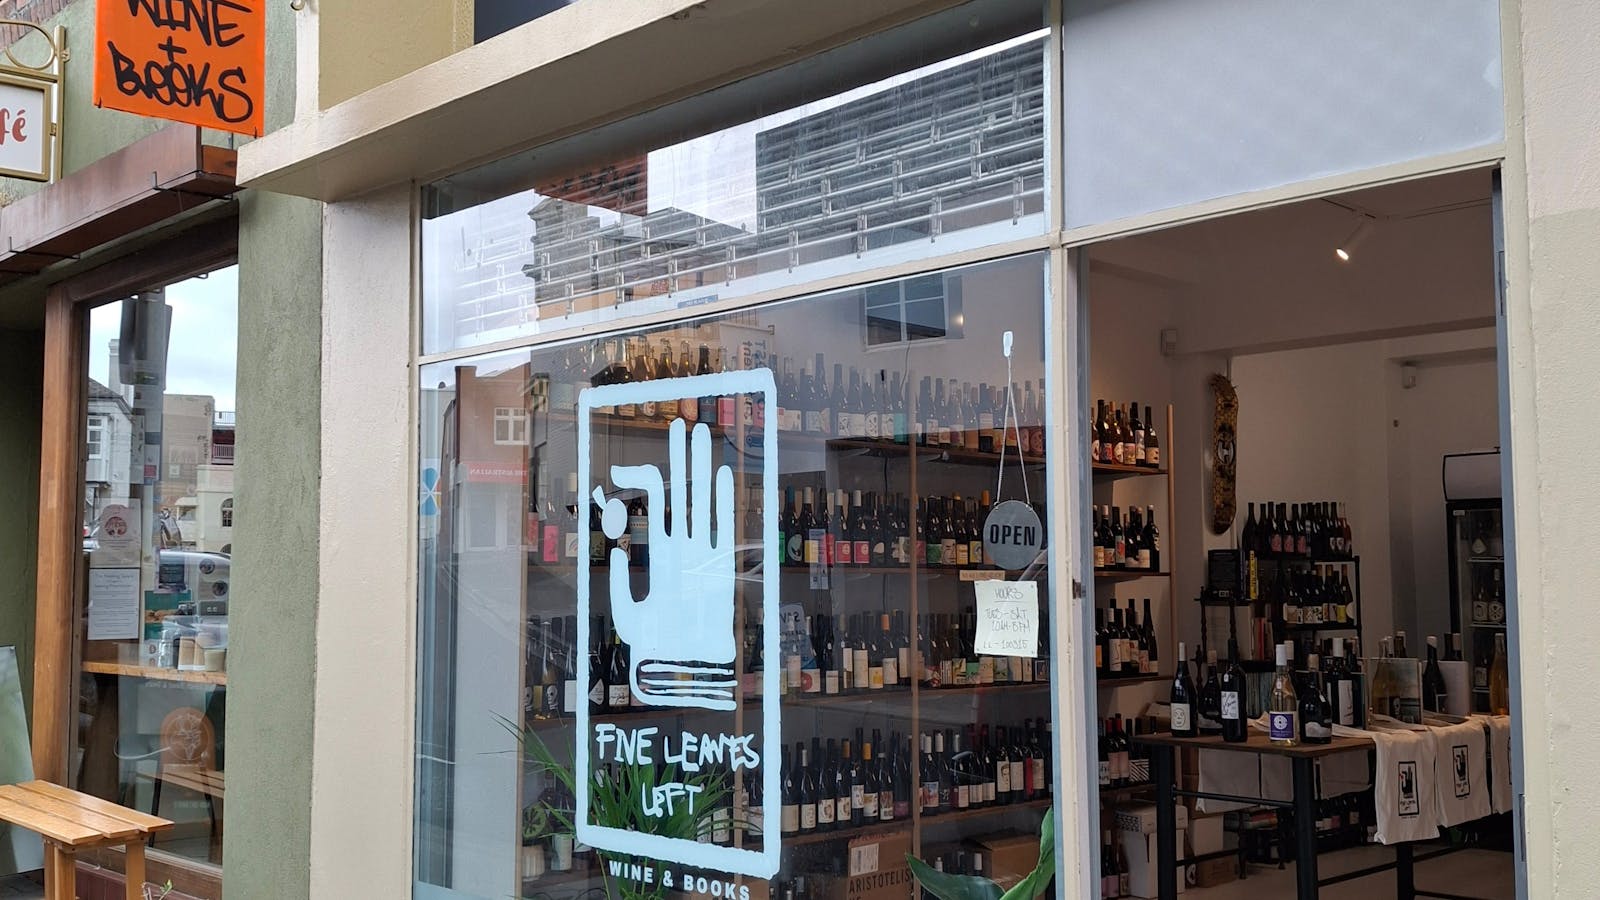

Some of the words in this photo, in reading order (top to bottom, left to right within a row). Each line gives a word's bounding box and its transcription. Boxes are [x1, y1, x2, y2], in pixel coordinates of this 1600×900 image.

[107, 41, 254, 123] BOOKS
[989, 524, 1036, 547] OPEN
[994, 586, 1024, 600] HOURS
[595, 723, 659, 766] FIVE
[664, 731, 760, 772] LEAVES
[642, 782, 704, 818] LEFT
[608, 860, 654, 884] WINE
[662, 870, 674, 888] &
[683, 874, 751, 900] BOOKS
